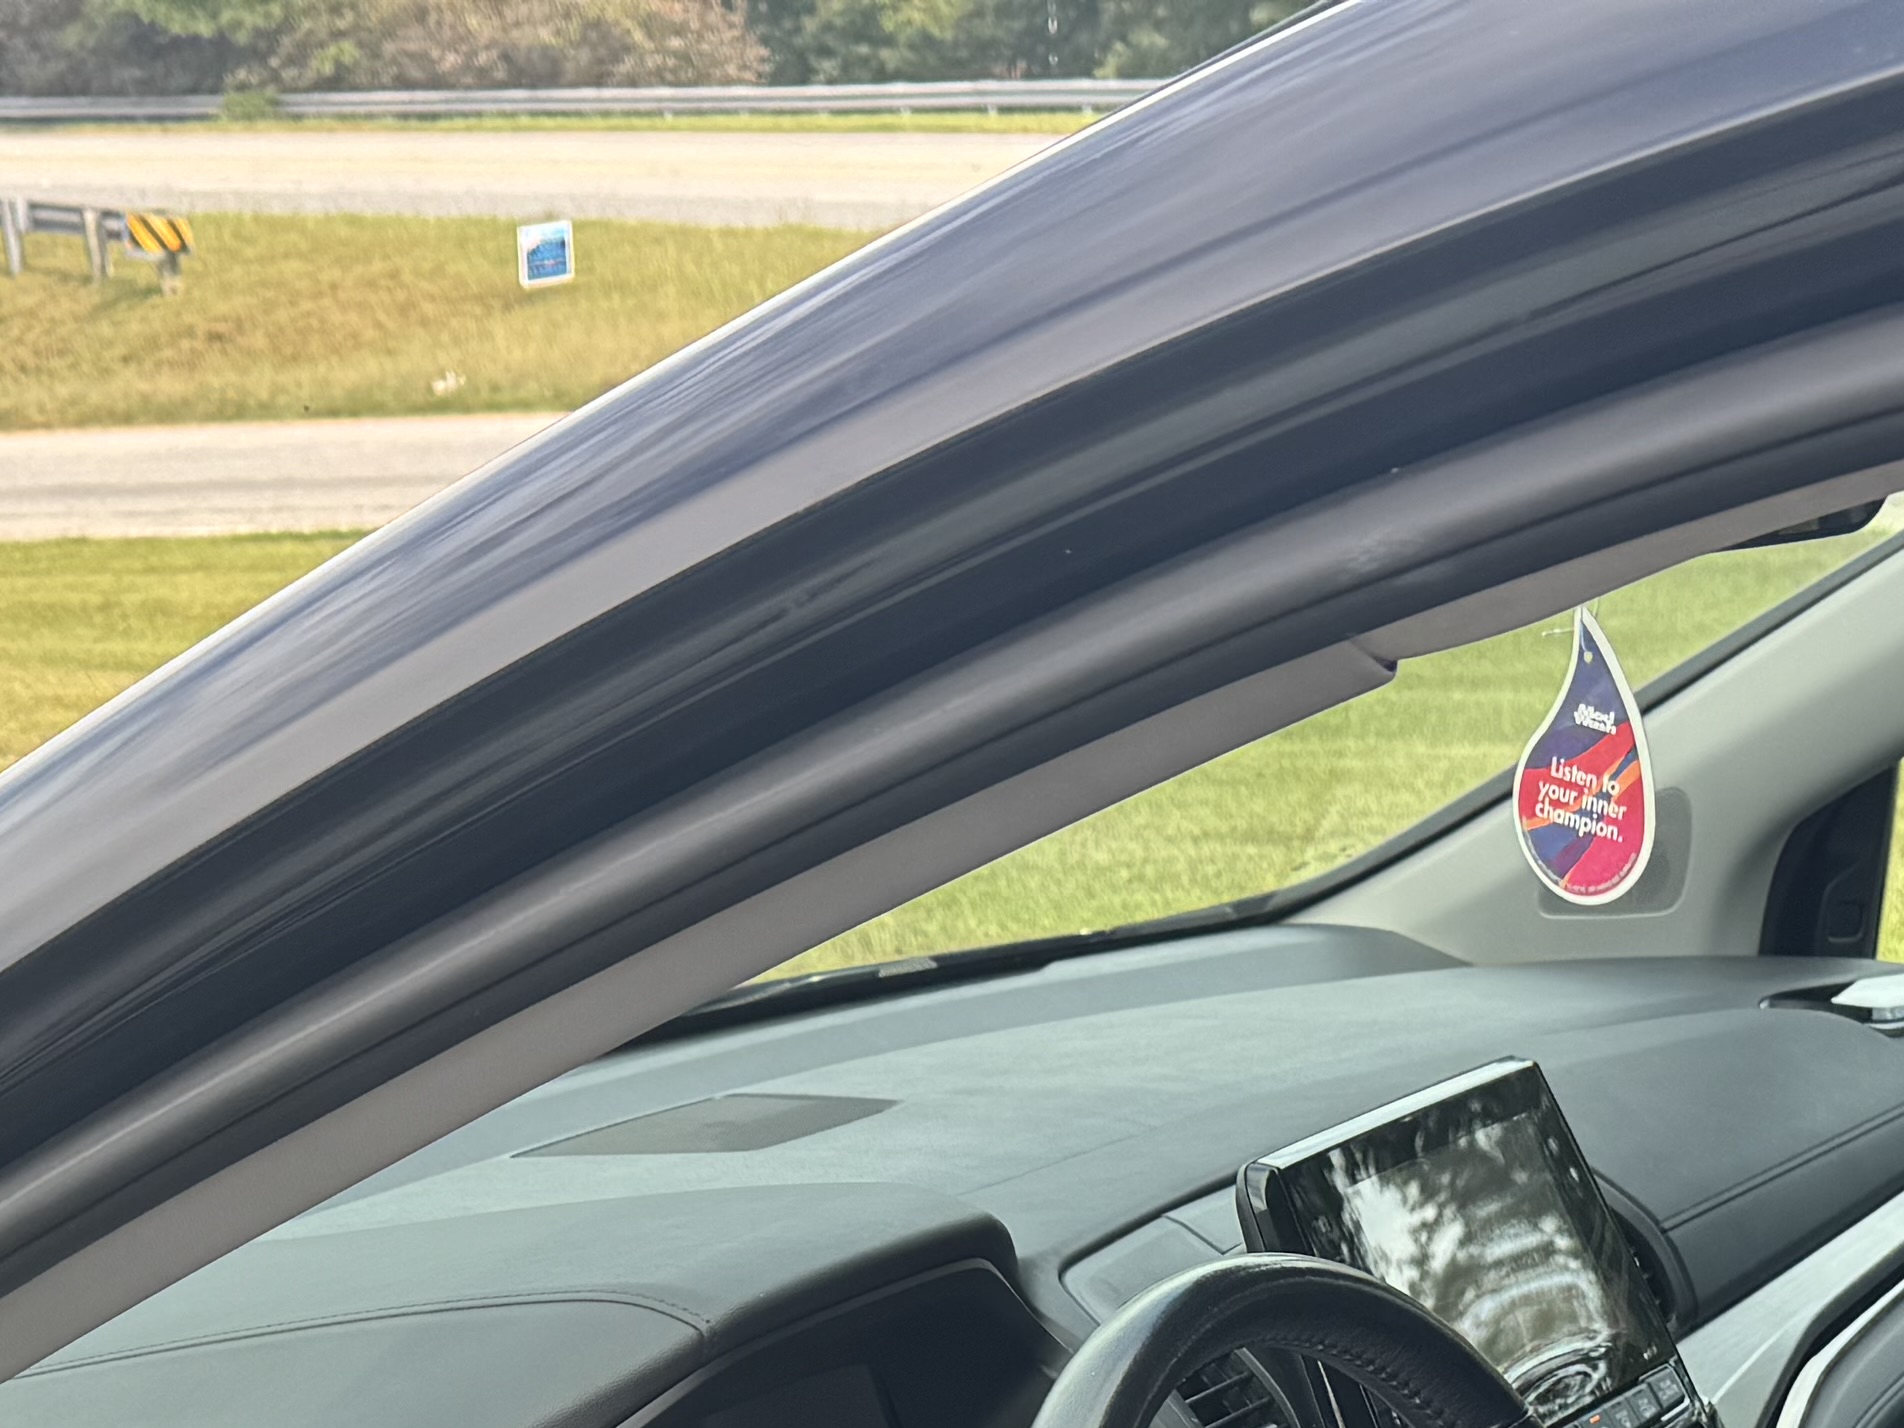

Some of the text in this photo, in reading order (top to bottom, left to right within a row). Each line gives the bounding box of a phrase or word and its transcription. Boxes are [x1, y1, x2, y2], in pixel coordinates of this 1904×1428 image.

[1550, 756, 1620, 796] Listen to
[1535, 796, 1623, 843] champion.
[1538, 780, 1627, 820] your inner
